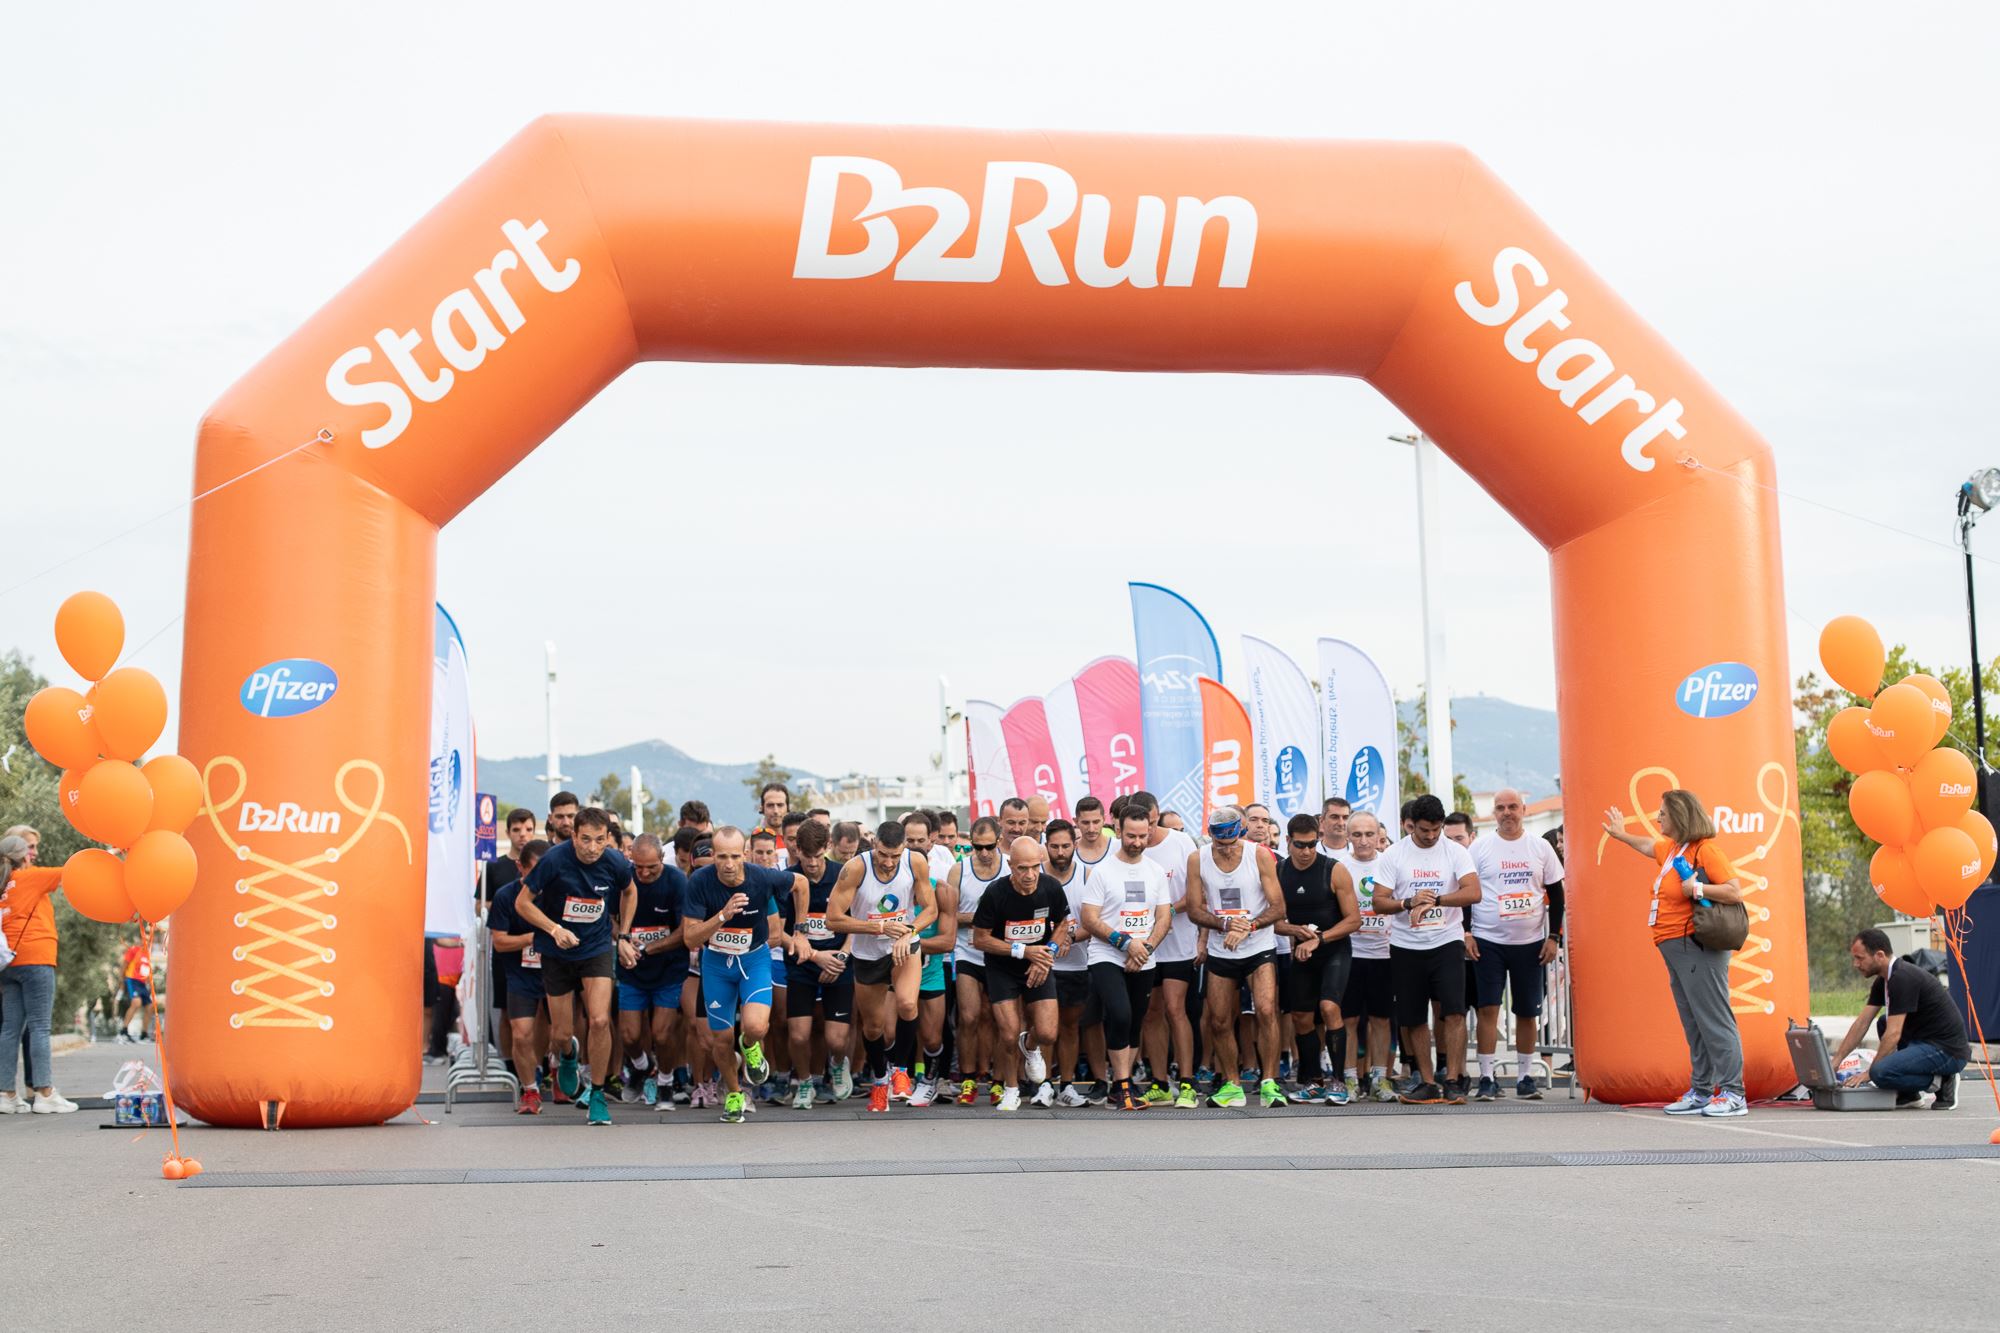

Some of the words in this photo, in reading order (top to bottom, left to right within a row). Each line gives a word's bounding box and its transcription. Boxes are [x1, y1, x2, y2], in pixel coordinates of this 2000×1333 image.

[792, 155, 1259, 289] B2Run
[325, 218, 581, 449] Start
[1454, 246, 1688, 472] Start
[247, 667, 335, 717] Pfizer
[1683, 670, 1757, 718] Pfizer
[238, 802, 341, 834] B2Run
[1707, 806, 1764, 834] Run
[572, 903, 602, 914] 6088
[1504, 898, 1531, 909] 5124
[638, 931, 667, 941] 6085
[716, 932, 748, 944] 6086
[807, 919, 827, 929] 08
[1012, 925, 1041, 935] 6210
